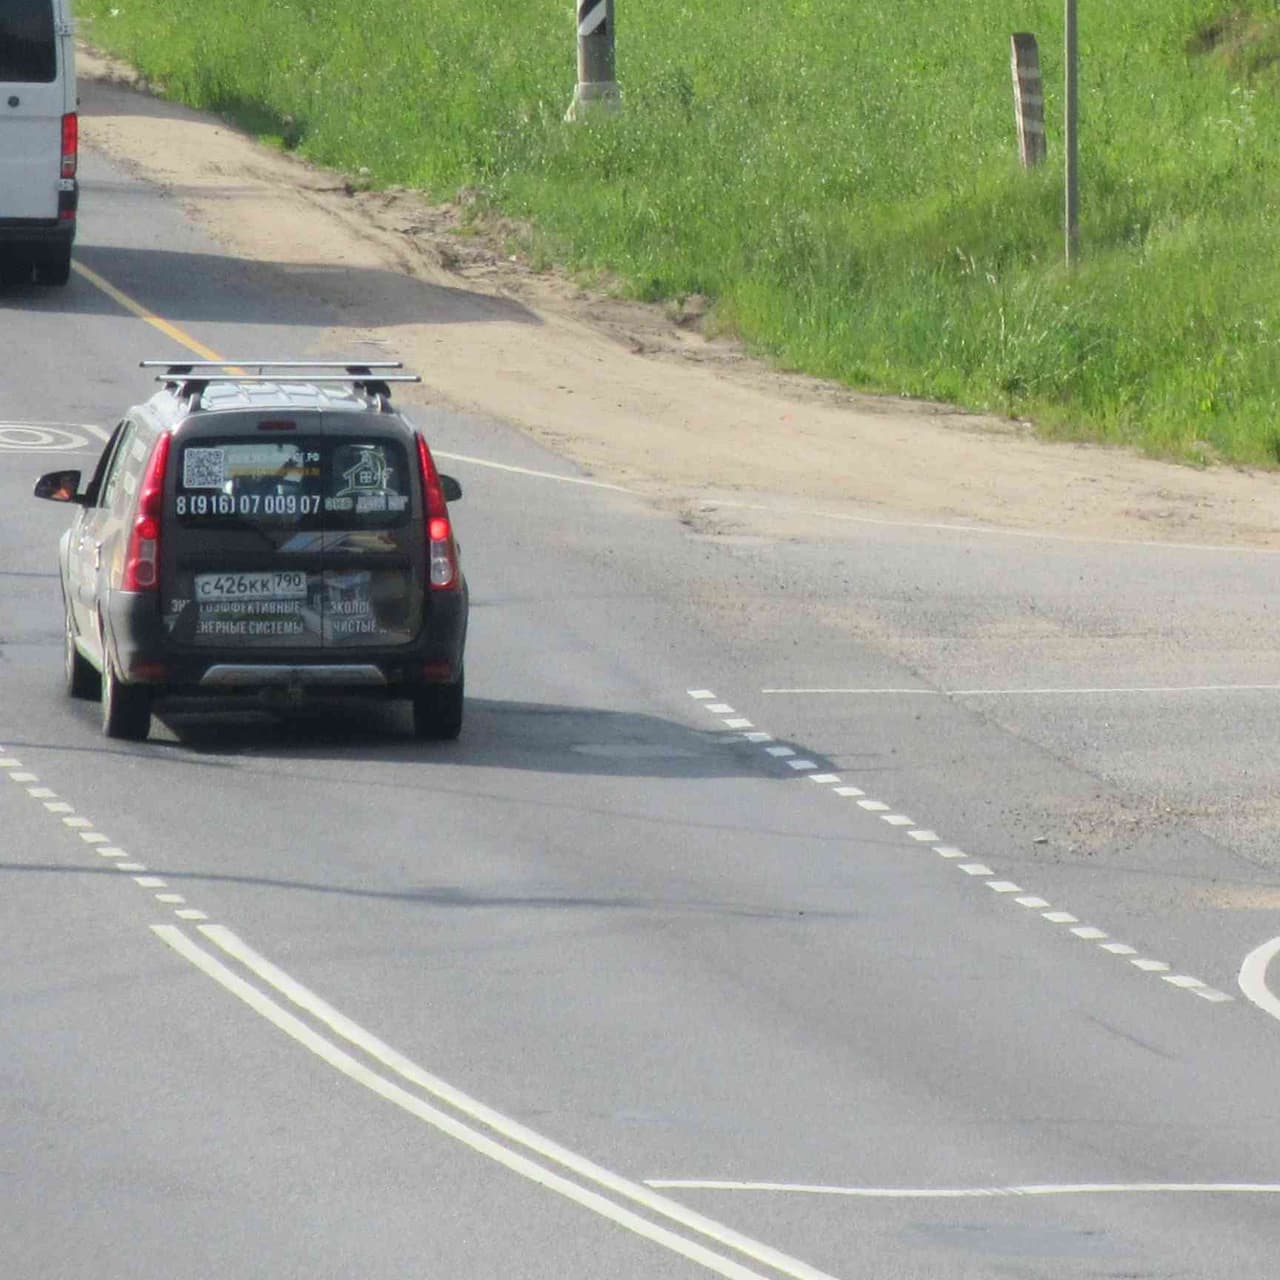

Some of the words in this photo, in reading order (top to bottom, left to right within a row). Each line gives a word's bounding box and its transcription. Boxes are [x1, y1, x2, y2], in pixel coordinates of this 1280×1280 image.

[176, 496, 186, 515] 8
[239, 495, 259, 514] 07
[300, 495, 321, 514] 07
